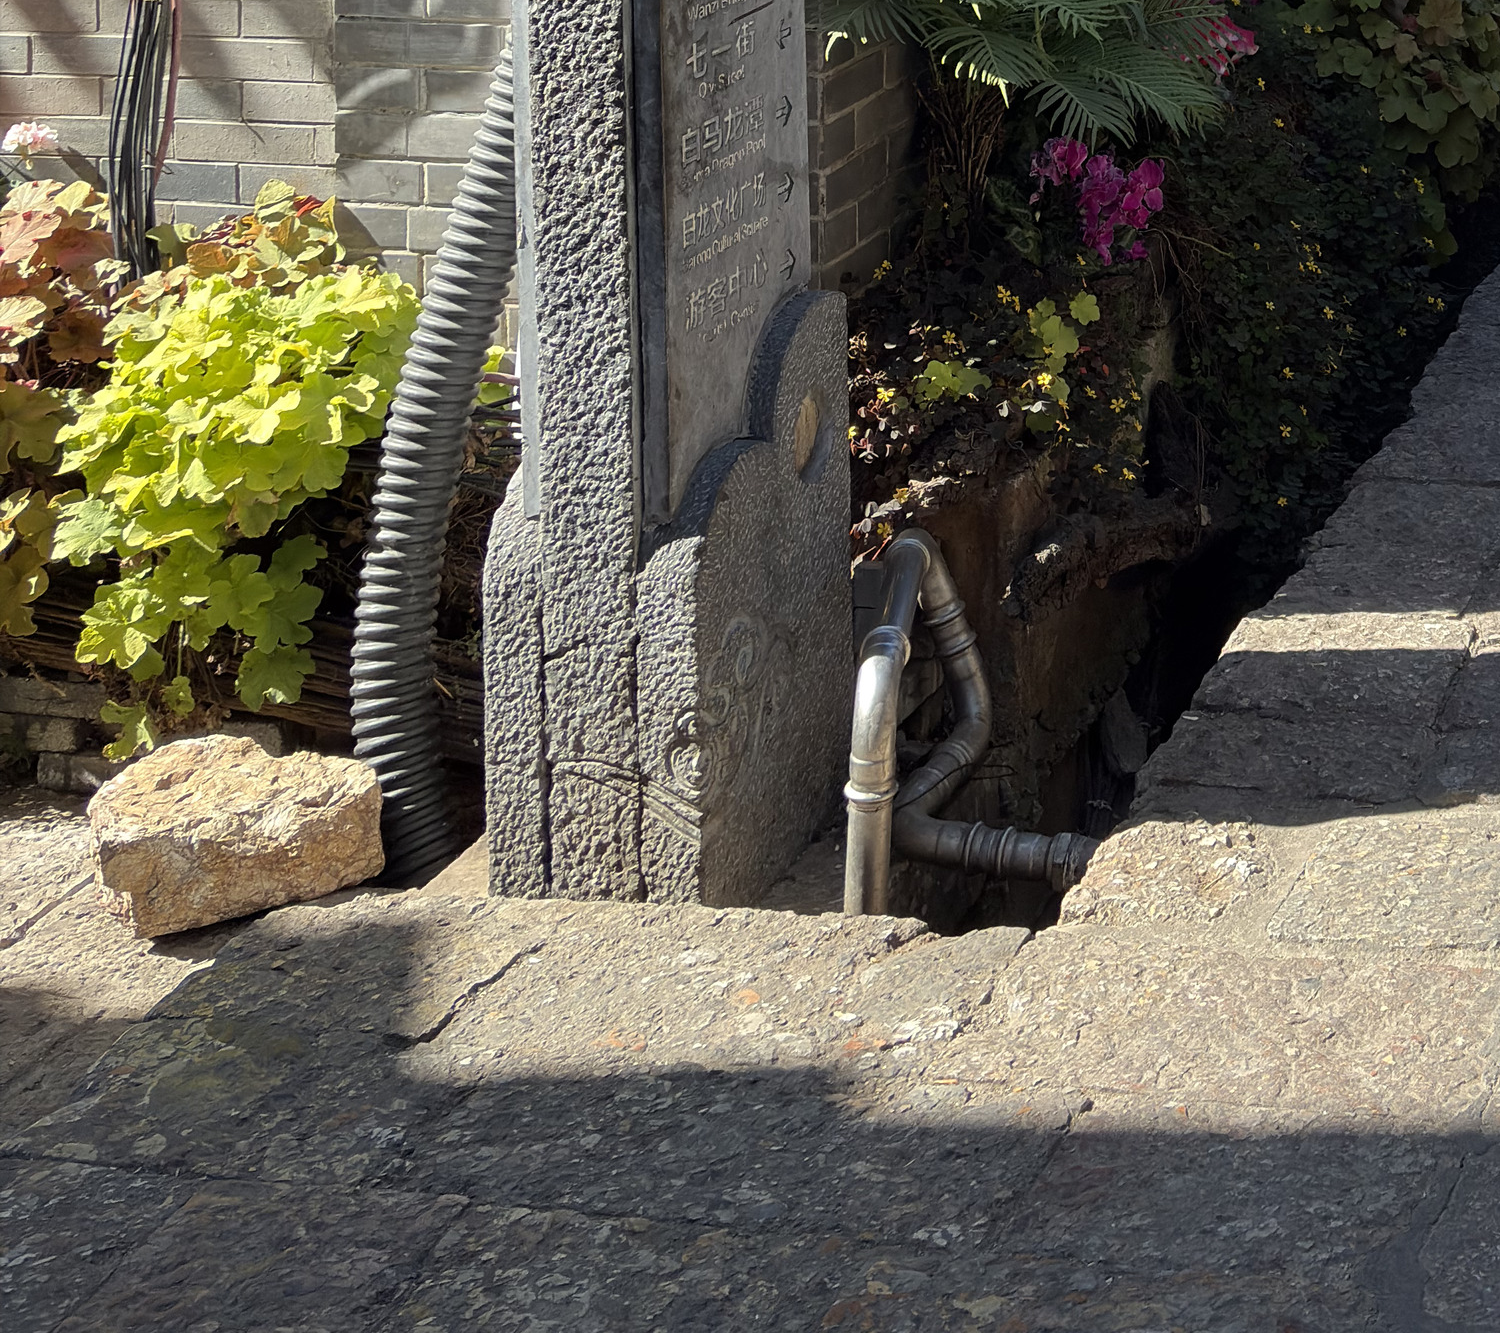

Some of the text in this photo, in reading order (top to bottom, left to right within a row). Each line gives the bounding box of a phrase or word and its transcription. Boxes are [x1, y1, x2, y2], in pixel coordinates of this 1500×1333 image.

[686, 20, 755, 80] 七一街
[681, 93, 765, 169] 白马龙潭
[682, 171, 766, 250] 白龙文化广场
[685, 250, 769, 333] 游客中心
